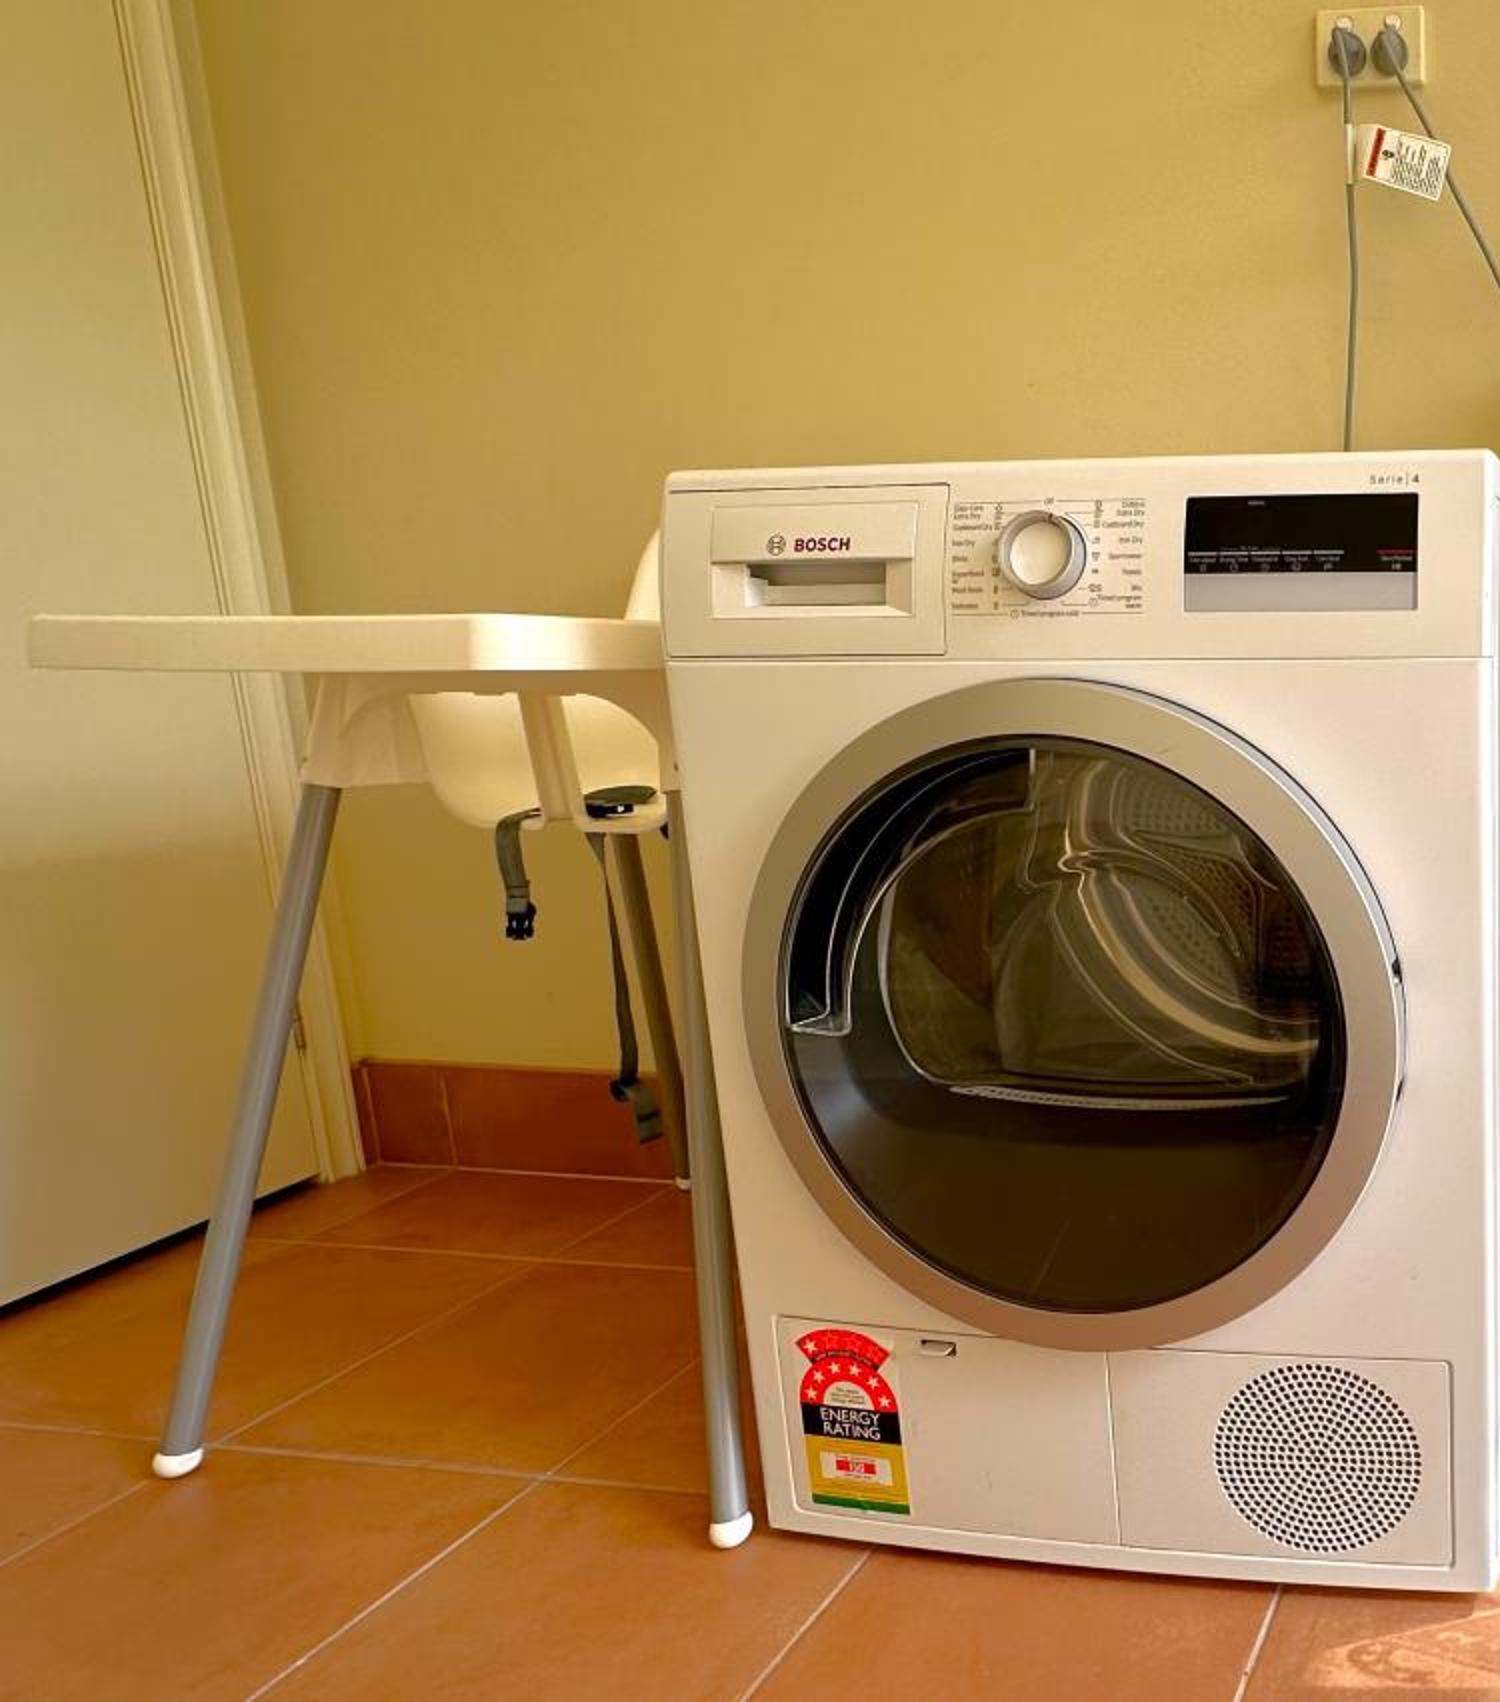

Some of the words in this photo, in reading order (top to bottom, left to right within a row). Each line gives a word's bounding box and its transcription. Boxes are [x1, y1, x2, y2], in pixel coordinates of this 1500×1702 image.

[794, 537, 851, 553] BOSCH
[819, 1406, 881, 1428] ENERGY
[822, 1421, 881, 1441] RATING
